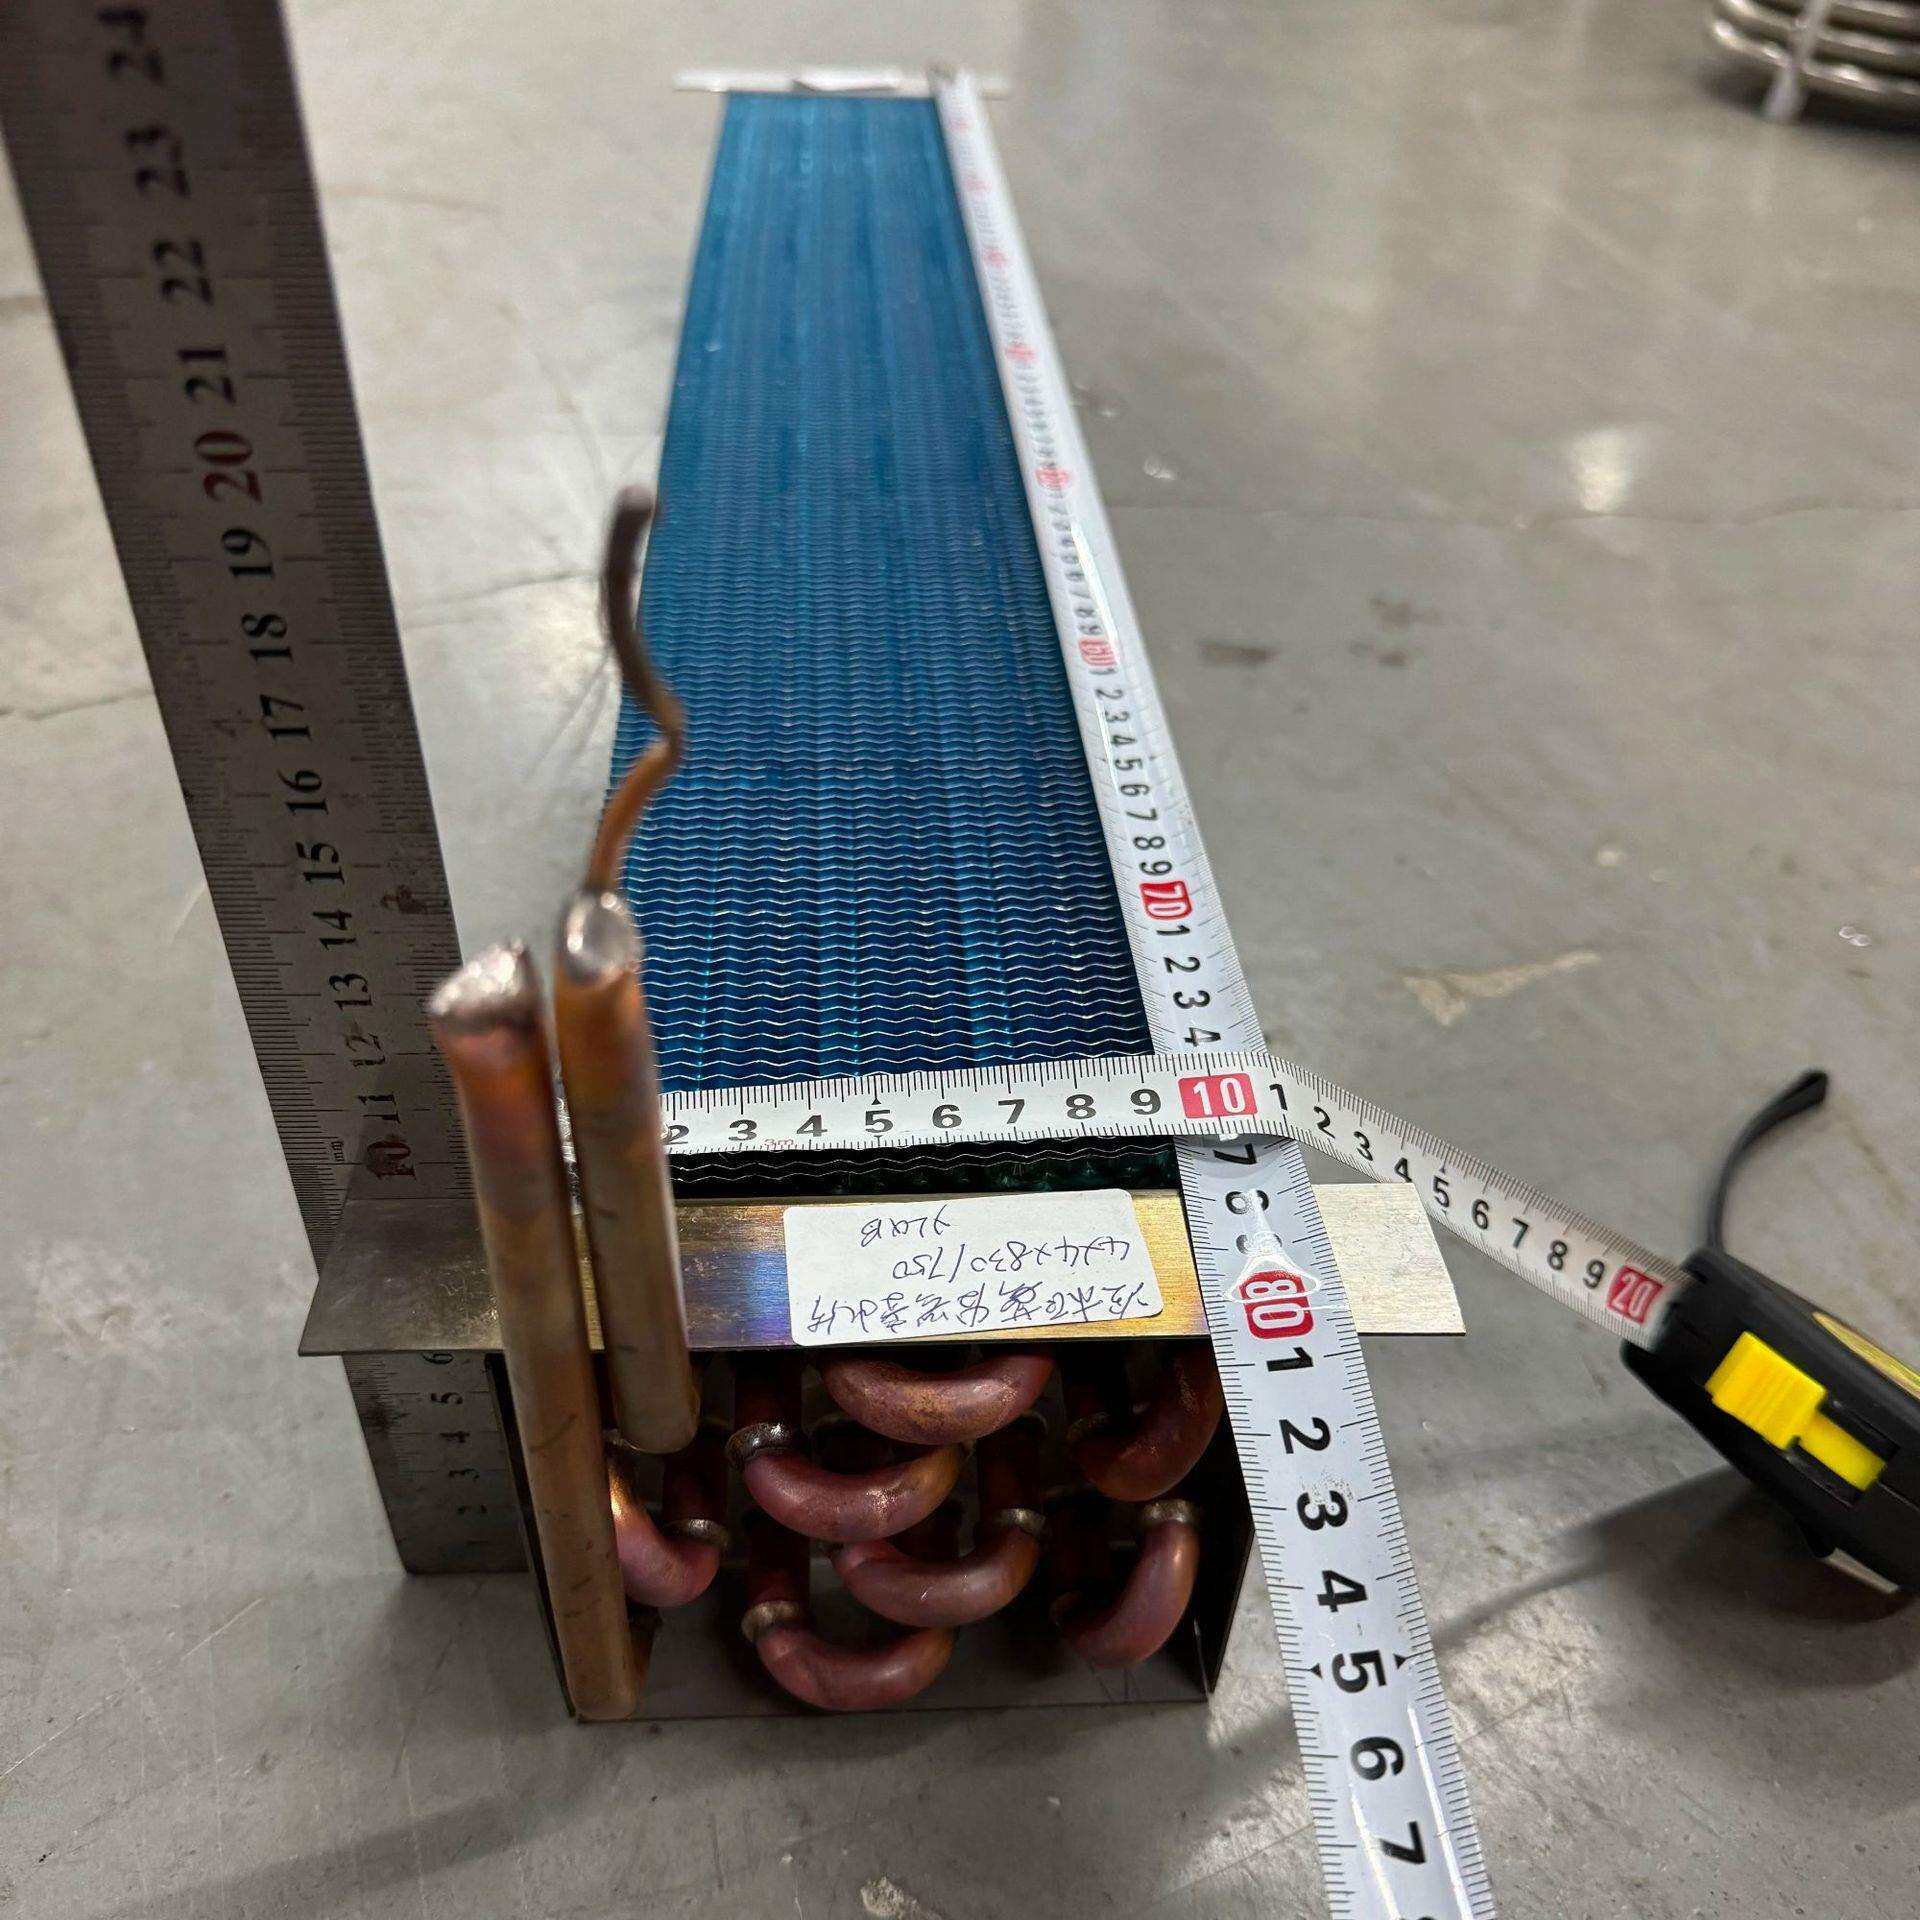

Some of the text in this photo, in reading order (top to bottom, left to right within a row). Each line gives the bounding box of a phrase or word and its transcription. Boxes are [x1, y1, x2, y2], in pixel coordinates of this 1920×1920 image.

[152, 240, 214, 305] 22
[178, 349, 236, 404] 21
[195, 430, 262, 503] 20
[220, 527, 274, 580] 19
[241, 613, 292, 663] 18
[1096, 689, 1122, 700] 2
[260, 695, 311, 741] 17
[1105, 710, 1130, 723] 3
[1111, 734, 1136, 747] 4
[1115, 757, 1143, 771] 5
[277, 770, 328, 815] 16
[1120, 783, 1150, 797] 6
[1127, 808, 1158, 821] 7
[1133, 836, 1165, 850] 8
[295, 842, 345, 885] 15
[1139, 860, 1172, 876] 9
[1143, 883, 1189, 918] 70
[312, 909, 356, 950] 14
[1157, 925, 1190, 936] 1
[1164, 956, 1200, 974] 2
[328, 973, 373, 1010] 13
[1173, 990, 1211, 1009] 3
[345, 1024, 386, 1067] 12
[1185, 1026, 1221, 1047] 4
[358, 1093, 400, 1124] 11
[1213, 1143, 1257, 1165] 7
[667, 1076, 1650, 1324] 2 3 4 5 6 7 8 9 10 1 2 3 4 5 6 7 8 9 20
[1244, 1278, 1307, 1330] 80
[1266, 1347, 1314, 1372] 1
[430, 1392, 463, 1405] 5
[439, 1431, 470, 1443] 4
[1278, 1417, 1331, 1454] 2
[1297, 1490, 1348, 1531] 3
[1317, 1569, 1368, 1613] 4
[1332, 1650, 1387, 1693] 5
[1350, 1737, 1404, 1781] 6
[1379, 1821, 1427, 1865] 7
